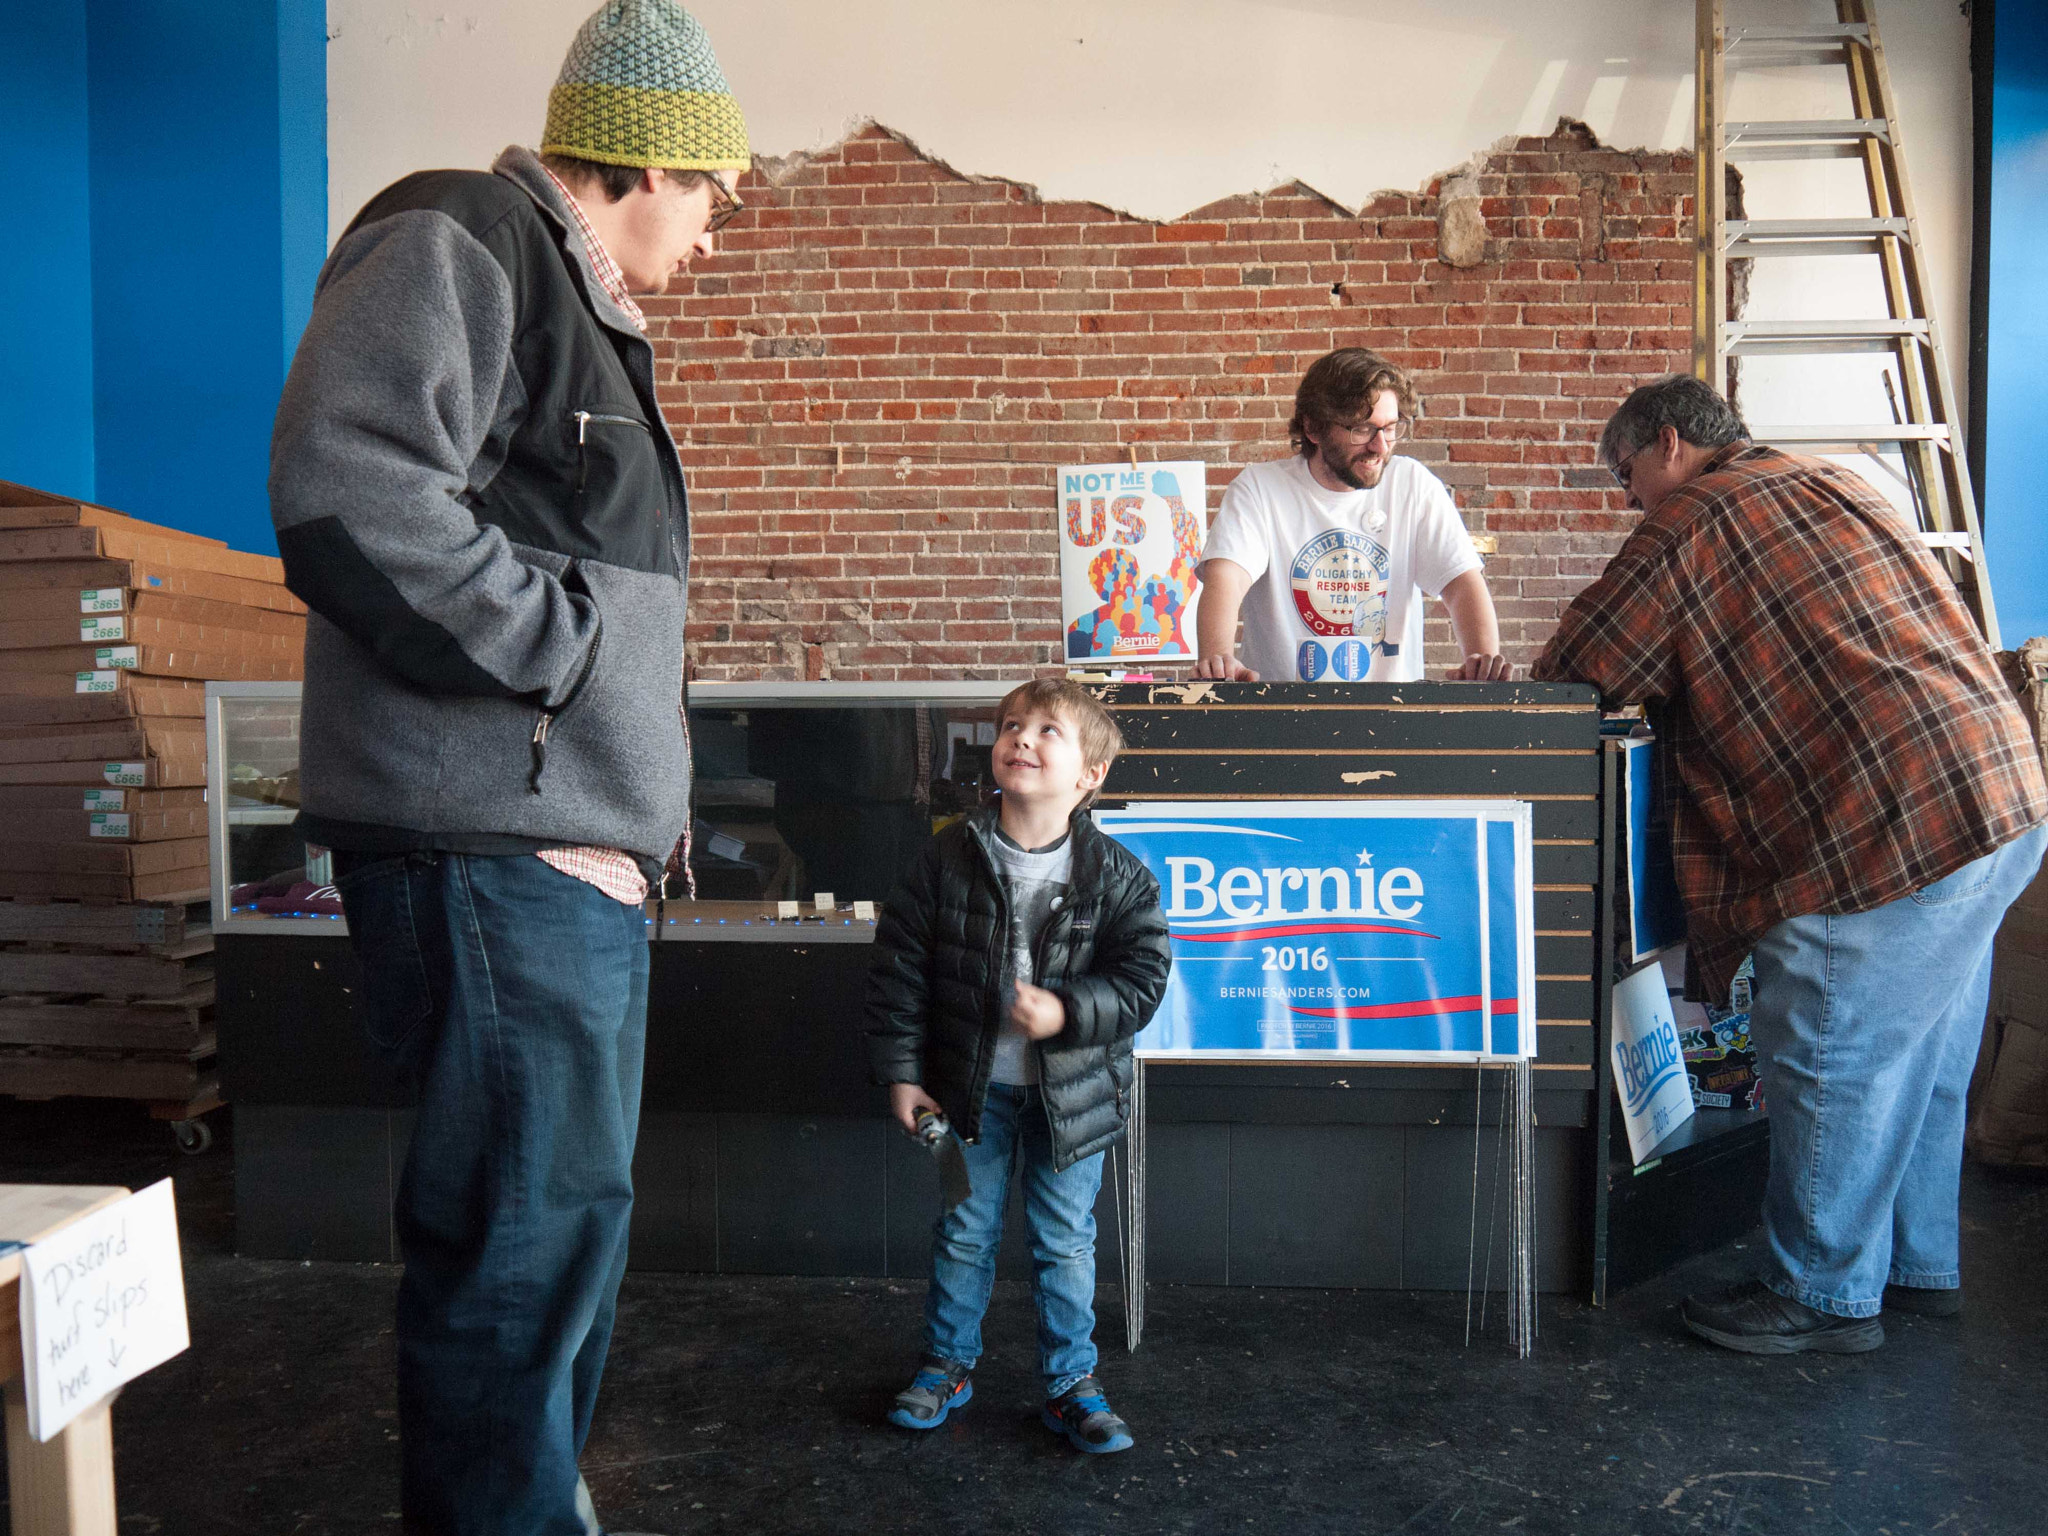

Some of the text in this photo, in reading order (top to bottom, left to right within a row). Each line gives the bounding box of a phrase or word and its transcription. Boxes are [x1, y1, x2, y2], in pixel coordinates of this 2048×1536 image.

[1066, 471, 1146, 493] NOT ME
[1066, 495, 1147, 548] US
[1297, 533, 1390, 574] BERNIE SANDERS
[1316, 569, 1372, 579] OLIGARCHY
[1316, 582, 1370, 591] RESPONSE
[92, 599, 120, 610] 5993
[1330, 594, 1357, 604] TEAM
[92, 627, 121, 638] 5993
[1303, 610, 1351, 636] 2016
[1113, 634, 1161, 647] Bernie
[1306, 644, 1316, 680] Bernie
[1350, 644, 1359, 680] Bernie
[87, 681, 114, 691] 5993
[114, 774, 143, 784] 5993
[101, 825, 127, 834] 5993
[1165, 851, 1424, 920] Bernie
[1262, 946, 1328, 972] 2016
[1220, 986, 1370, 999] BERNIESANDERS.COM
[1318, 1022, 1332, 1030] 2016
[1616, 1016, 1678, 1100] Bernie
[1702, 1094, 1730, 1106] SOCIETY
[1653, 1106, 1670, 1134] 2016
[43, 1218, 128, 1306] Discard
[95, 1278, 149, 1328] slips
[57, 1364, 92, 1407] here
